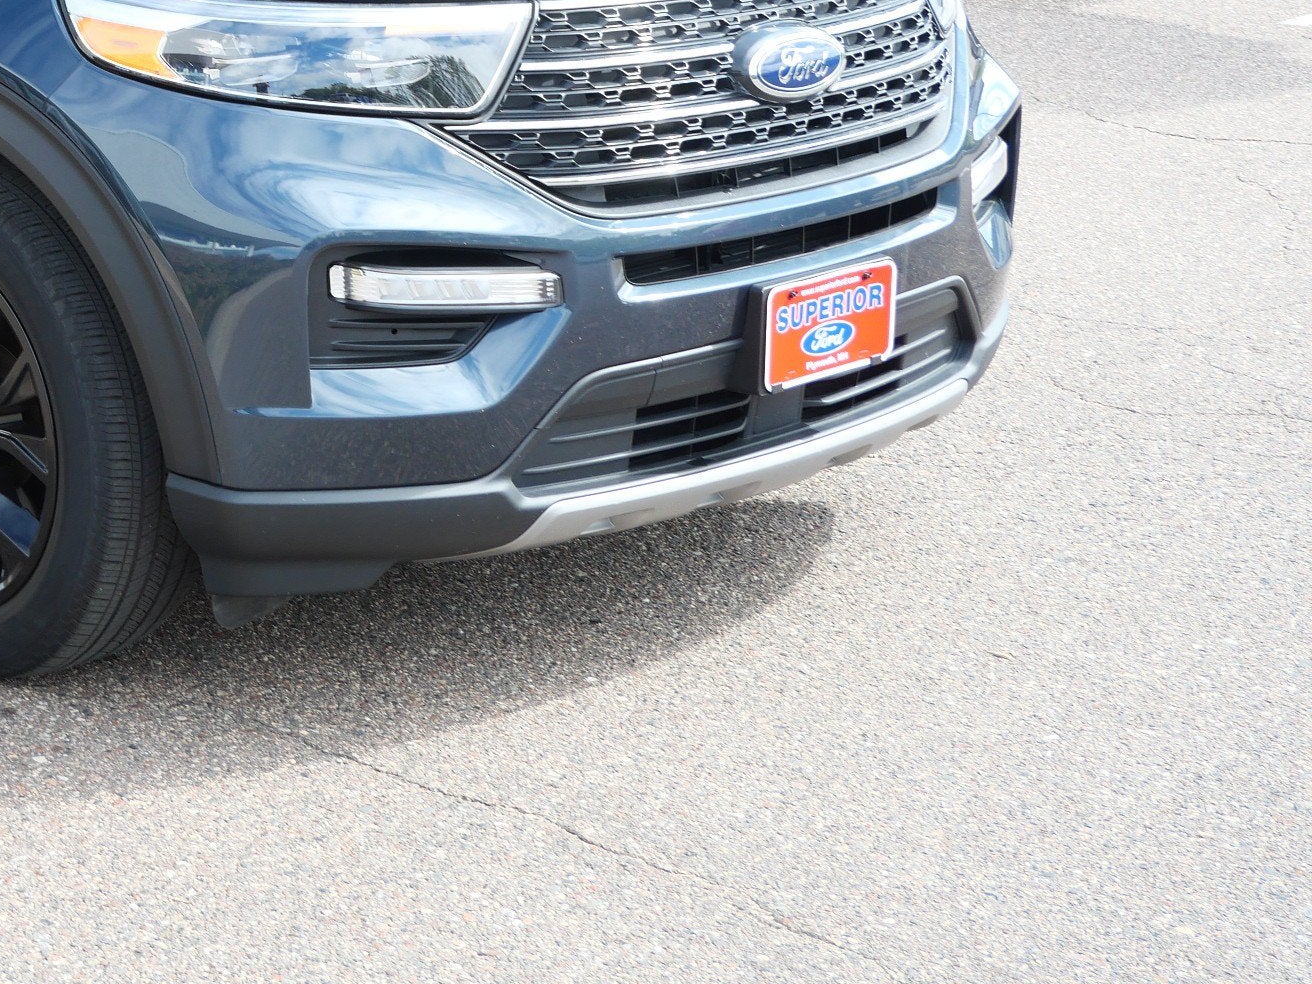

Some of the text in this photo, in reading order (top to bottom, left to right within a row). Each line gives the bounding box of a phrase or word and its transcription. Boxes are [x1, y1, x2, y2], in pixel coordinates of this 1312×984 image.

[777, 45, 830, 85] Ford
[776, 283, 883, 333] SUPERIOR
[810, 325, 845, 351] Ford
